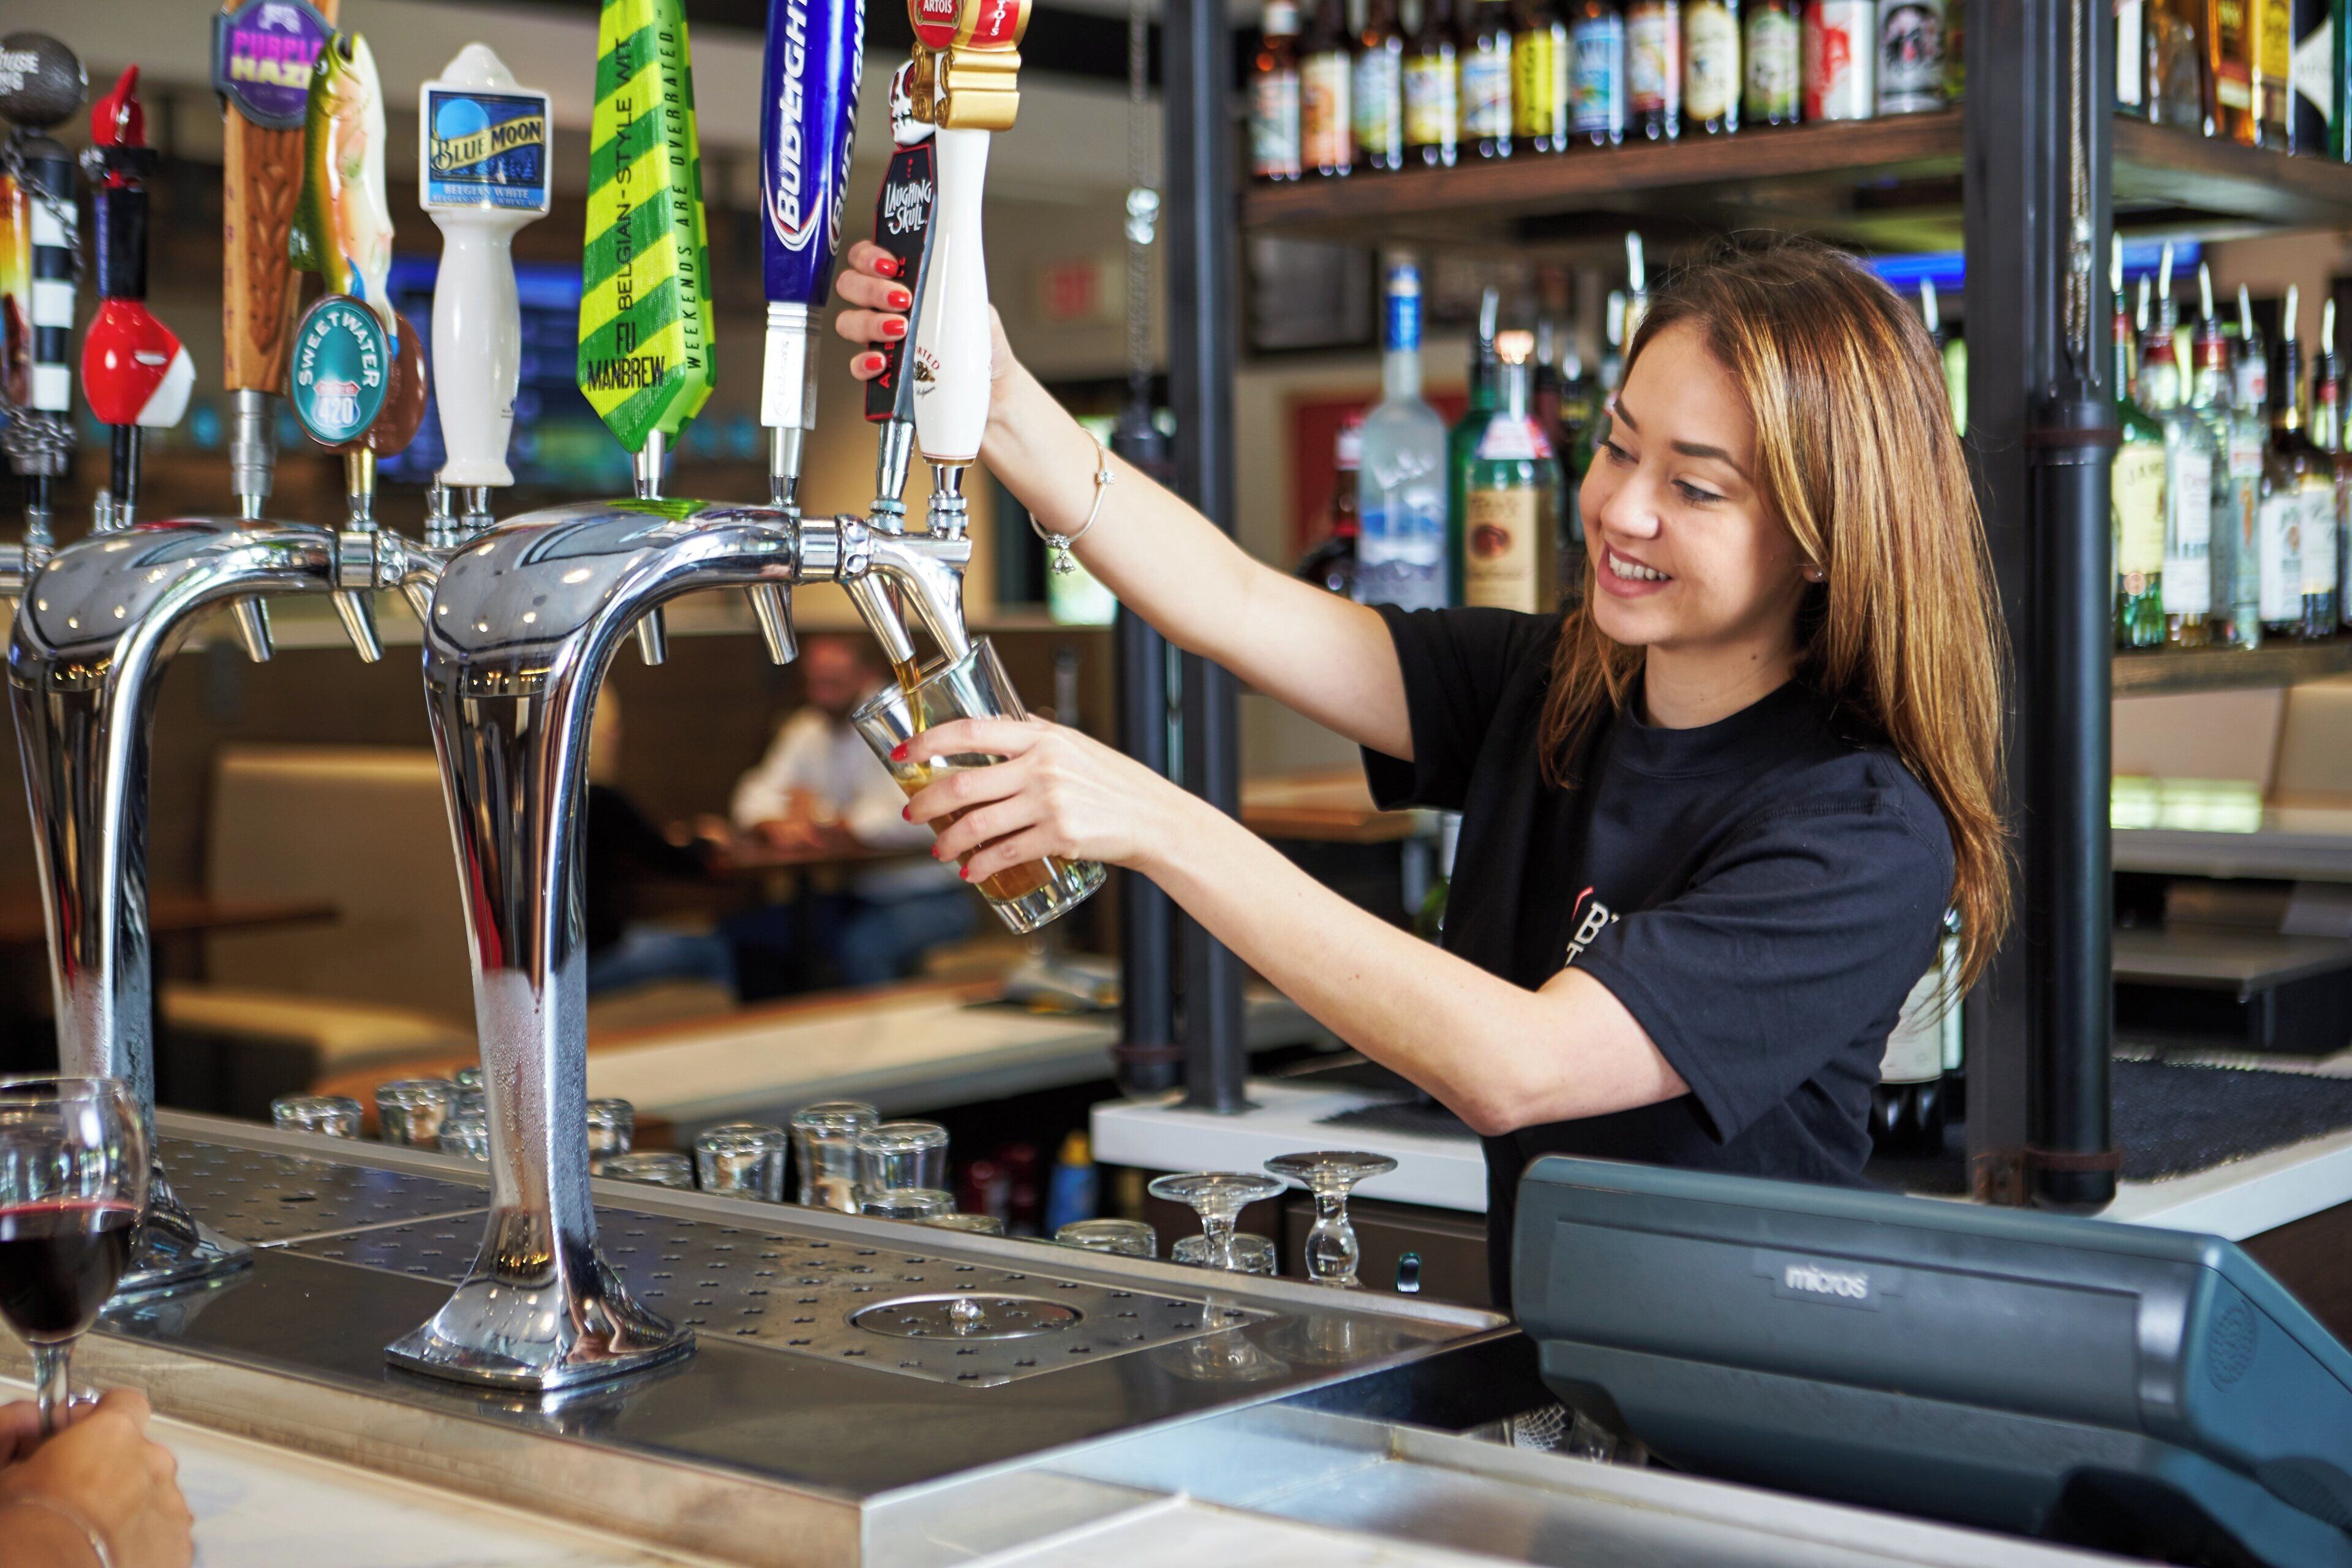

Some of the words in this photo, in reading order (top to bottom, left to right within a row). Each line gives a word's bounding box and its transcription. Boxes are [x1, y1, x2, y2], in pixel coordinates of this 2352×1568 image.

[924, 0, 952, 14] ARTOIS
[990, 0, 1006, 36] TOIS
[616, 38, 632, 91] WIT
[431, 135, 488, 172] BLUE
[491, 121, 541, 151] MOON
[444, 184, 490, 199] BELGIAN
[492, 188, 529, 200] WHITE
[778, 124, 801, 232] BUD
[832, 132, 854, 235] BUD
[884, 178, 932, 218] LAUGHING
[616, 98, 633, 311] BELGIAN-STYLE
[673, 185, 690, 227] ARE
[678, 246, 702, 369] WEEKENDS
[298, 311, 380, 388] SWEETWATER
[616, 322, 636, 355] FU
[588, 356, 665, 392] MANBREW
[318, 397, 353, 424] 420
[1785, 1262, 1869, 1299] micros
